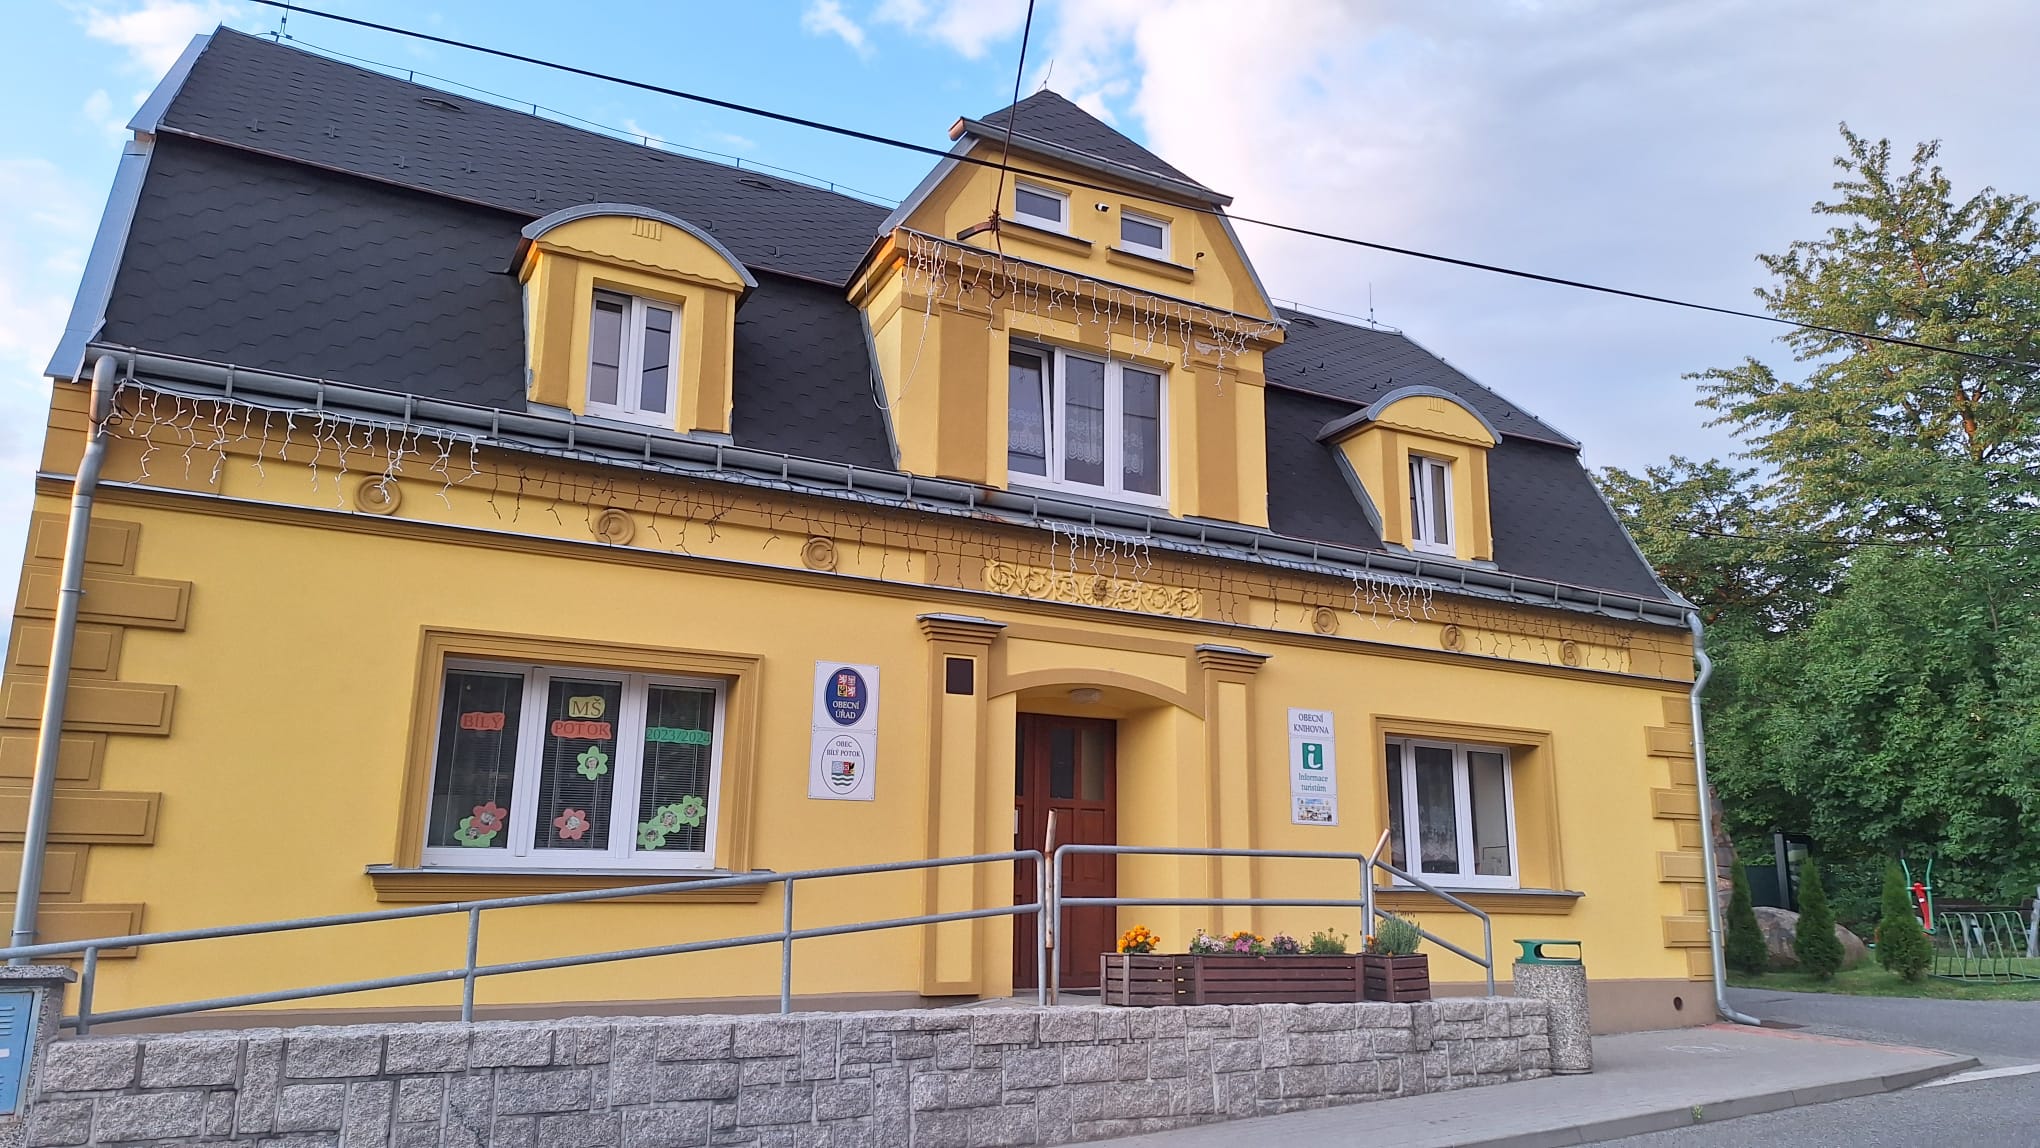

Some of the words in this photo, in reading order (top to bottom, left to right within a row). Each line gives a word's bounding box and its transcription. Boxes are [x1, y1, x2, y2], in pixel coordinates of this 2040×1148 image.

[572, 699, 602, 717] MŠ
[832, 700, 860, 710] OBECNÍ
[835, 709, 856, 720] ÚŘAD
[1298, 713, 1324, 723] OBECNÍ
[463, 713, 503, 728] BÍLÝ
[554, 723, 610, 737] POTOK
[1293, 723, 1330, 735] KNIHOVNA
[646, 729, 710, 743] 2023/2024
[836, 740, 852, 748] OBEC
[840, 749, 861, 757] POTOK
[1298, 772, 1328, 782] Informace
[1301, 783, 1327, 793] turistům
